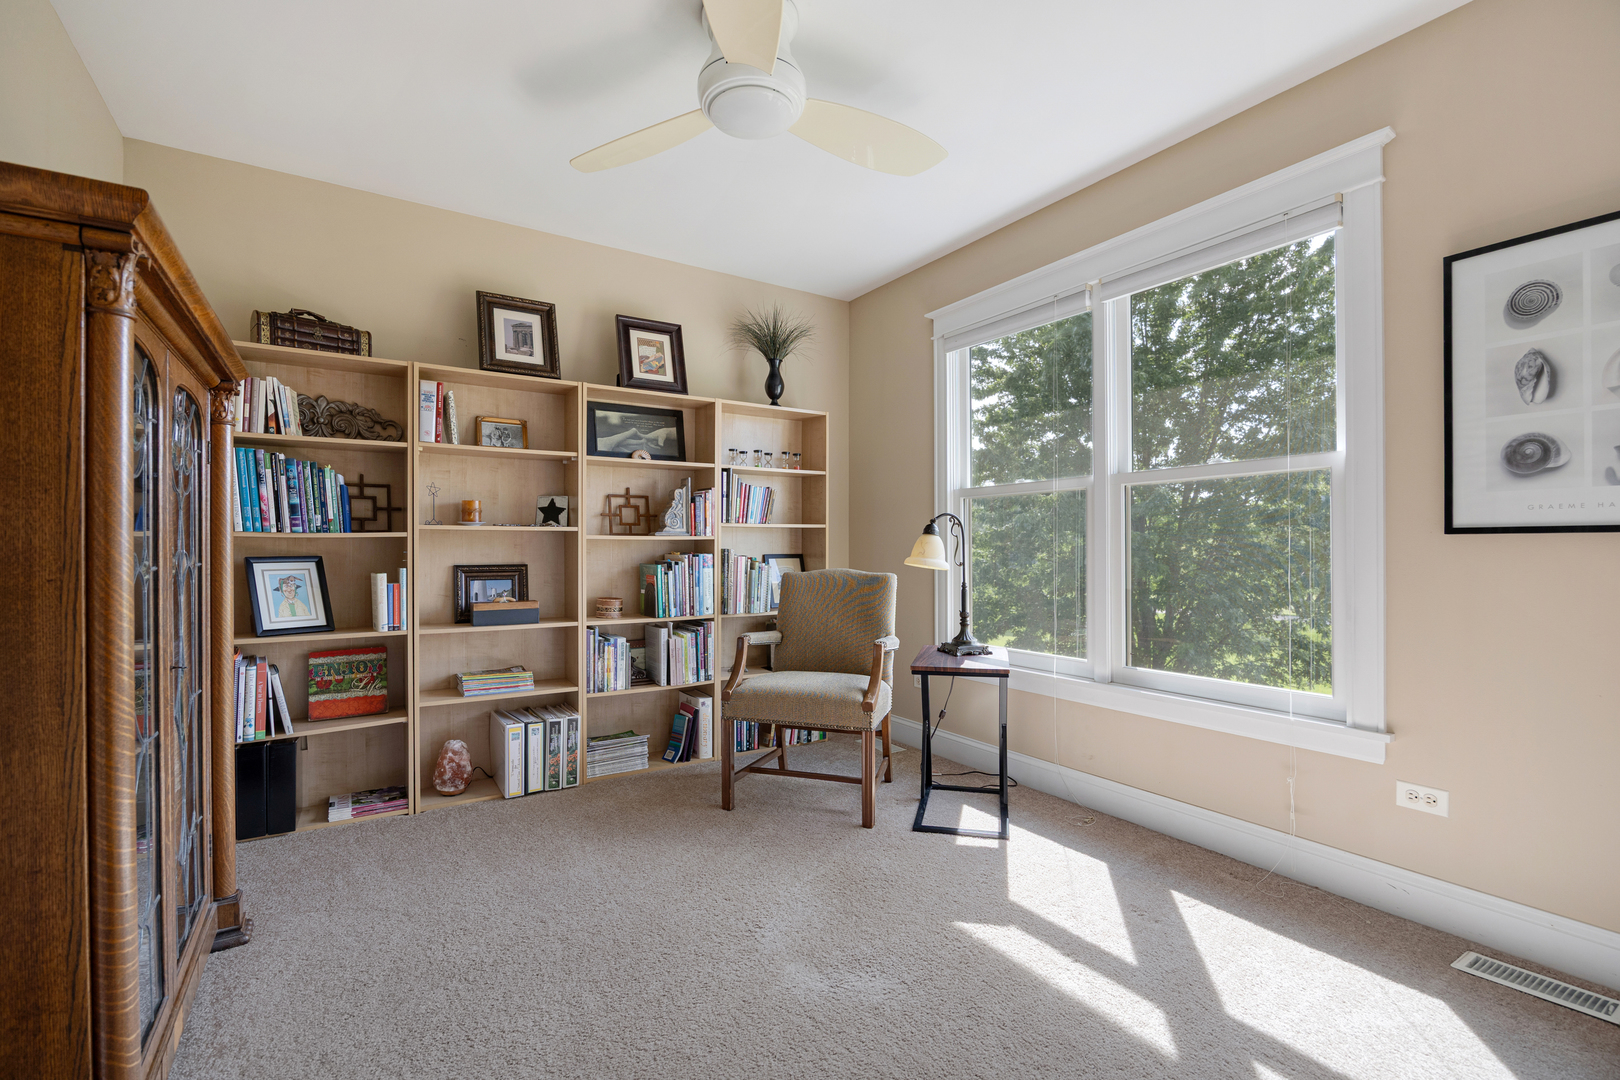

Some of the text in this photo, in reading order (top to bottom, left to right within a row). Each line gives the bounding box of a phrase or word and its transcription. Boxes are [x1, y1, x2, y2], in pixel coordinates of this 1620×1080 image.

[1527, 502, 1585, 510] GRAEME
[312, 659, 383, 677] ENJOY
[351, 677, 382, 695] Life
[701, 713, 709, 748] dictionary
